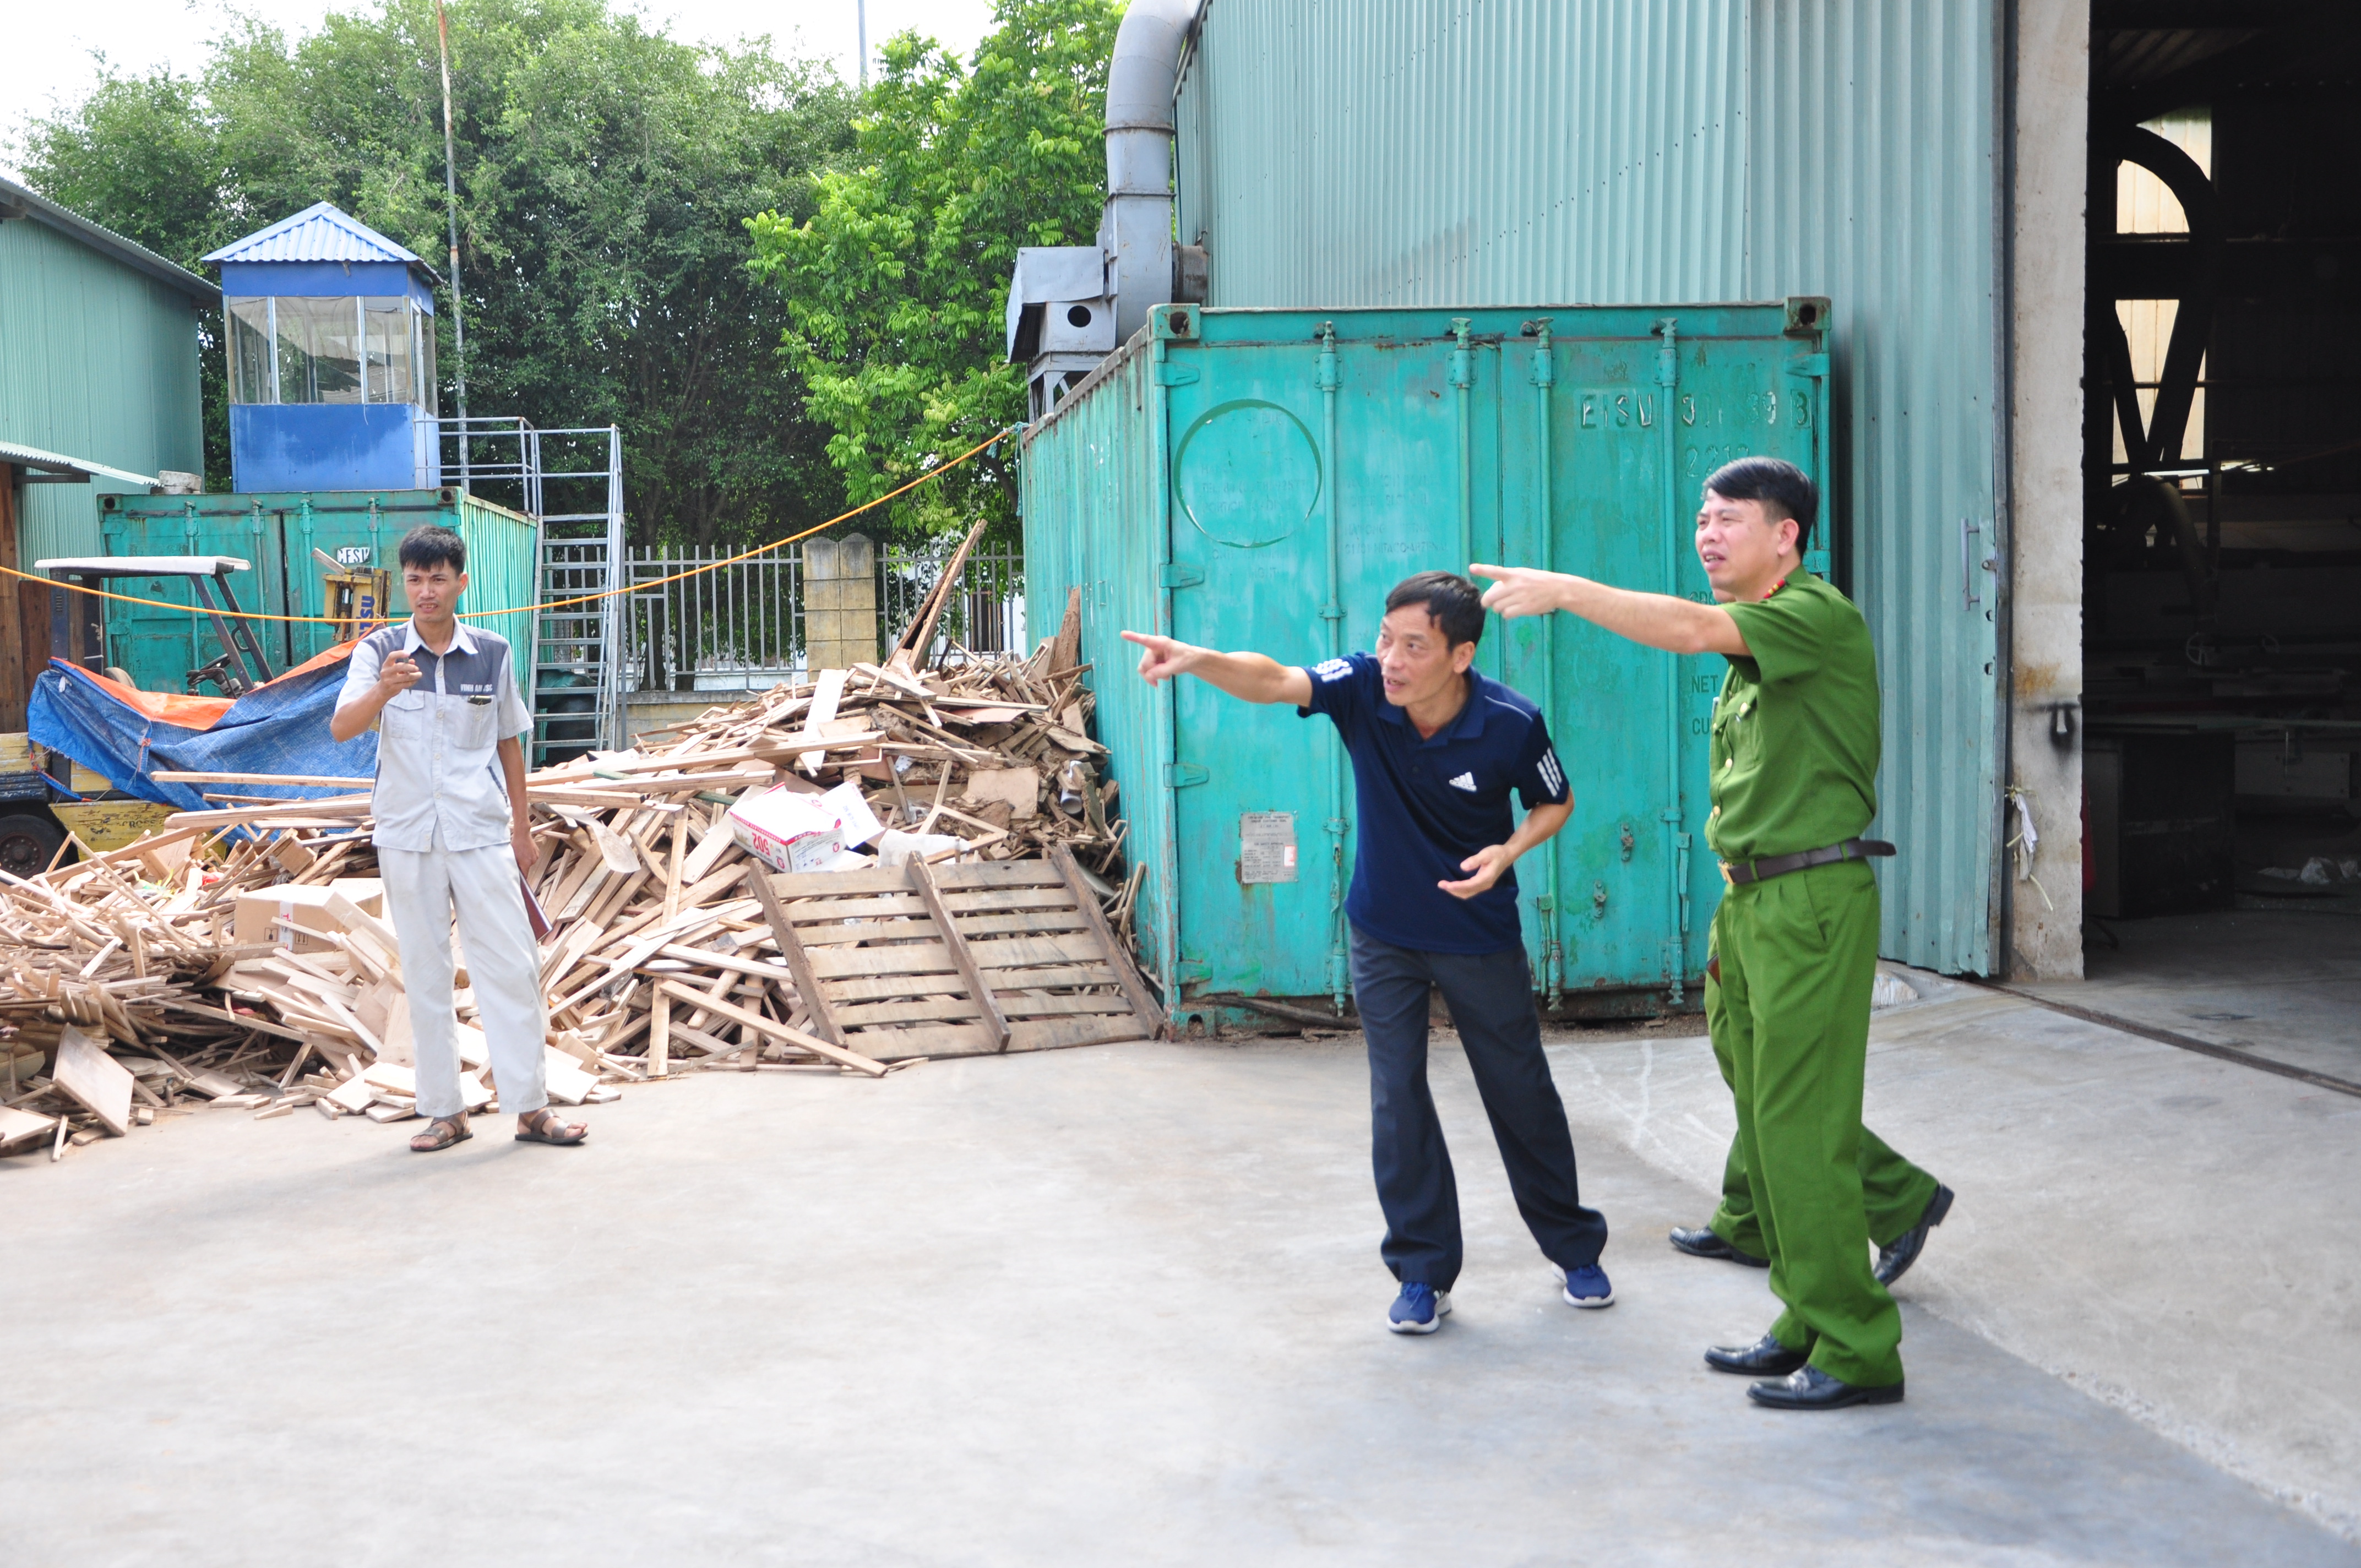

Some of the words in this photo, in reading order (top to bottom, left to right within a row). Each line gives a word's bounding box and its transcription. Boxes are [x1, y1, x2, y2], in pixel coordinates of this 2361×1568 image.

[1581, 394, 1653, 428] EISU
[1690, 675, 1719, 693] NET
[1691, 718, 1711, 735] CU
[752, 832, 771, 856] 502
